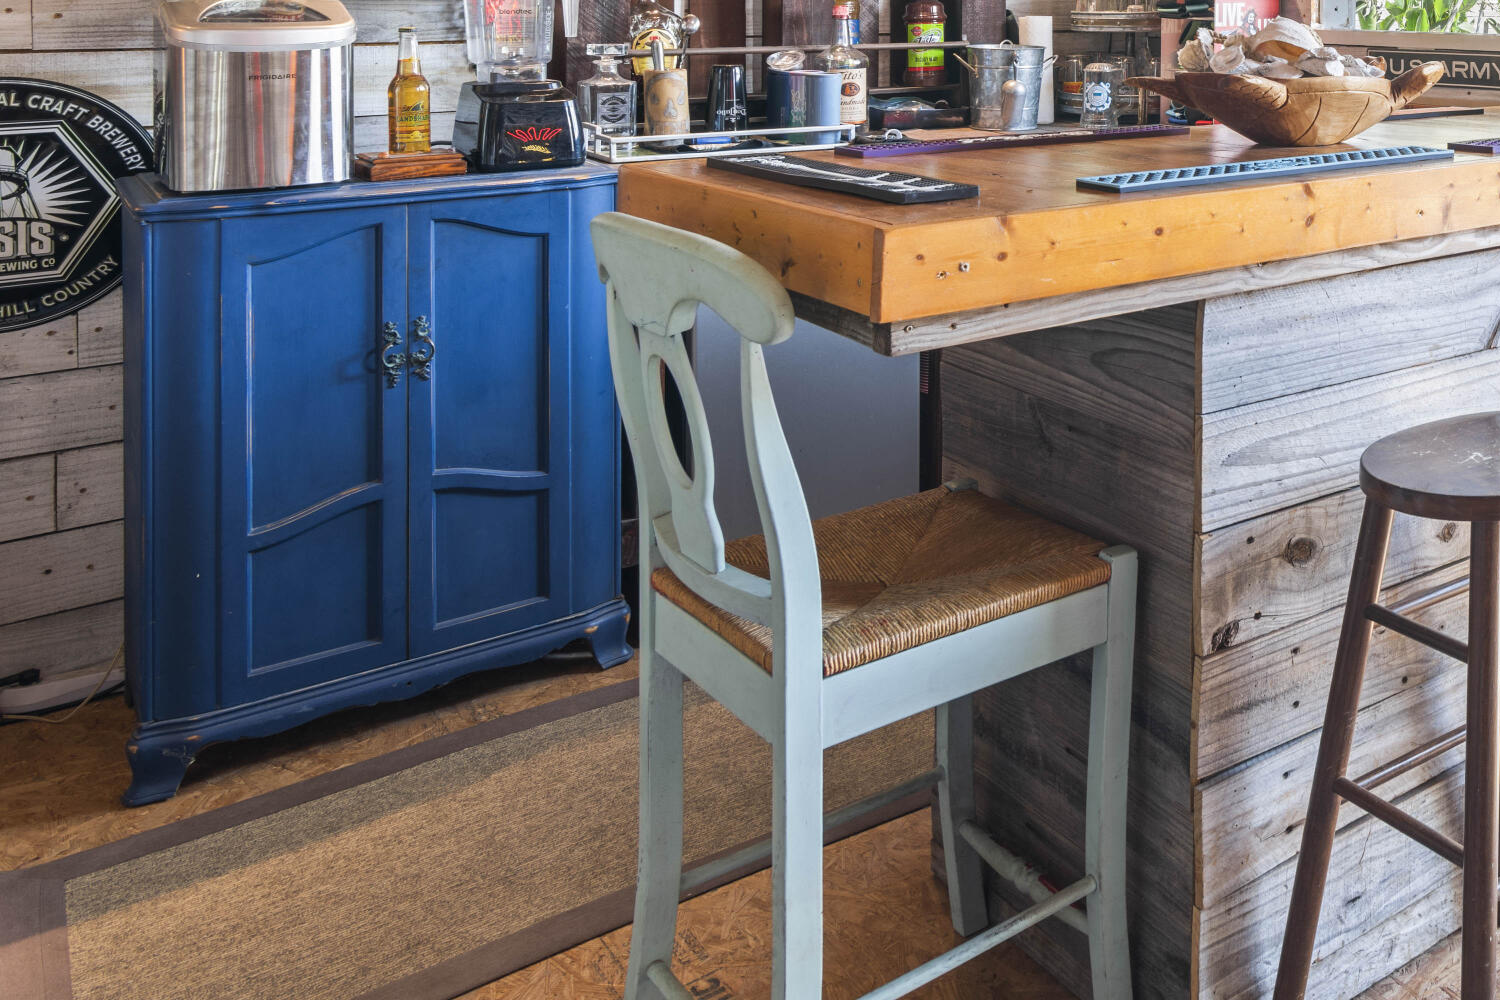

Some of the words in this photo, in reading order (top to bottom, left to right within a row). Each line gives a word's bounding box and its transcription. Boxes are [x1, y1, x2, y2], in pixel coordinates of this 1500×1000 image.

[1214, 1, 1247, 28] LIVE
[28, 94, 91, 122] CRAFT
[86, 114, 147, 173] BREWERY
[41, 255, 119, 308] COUNTRY
